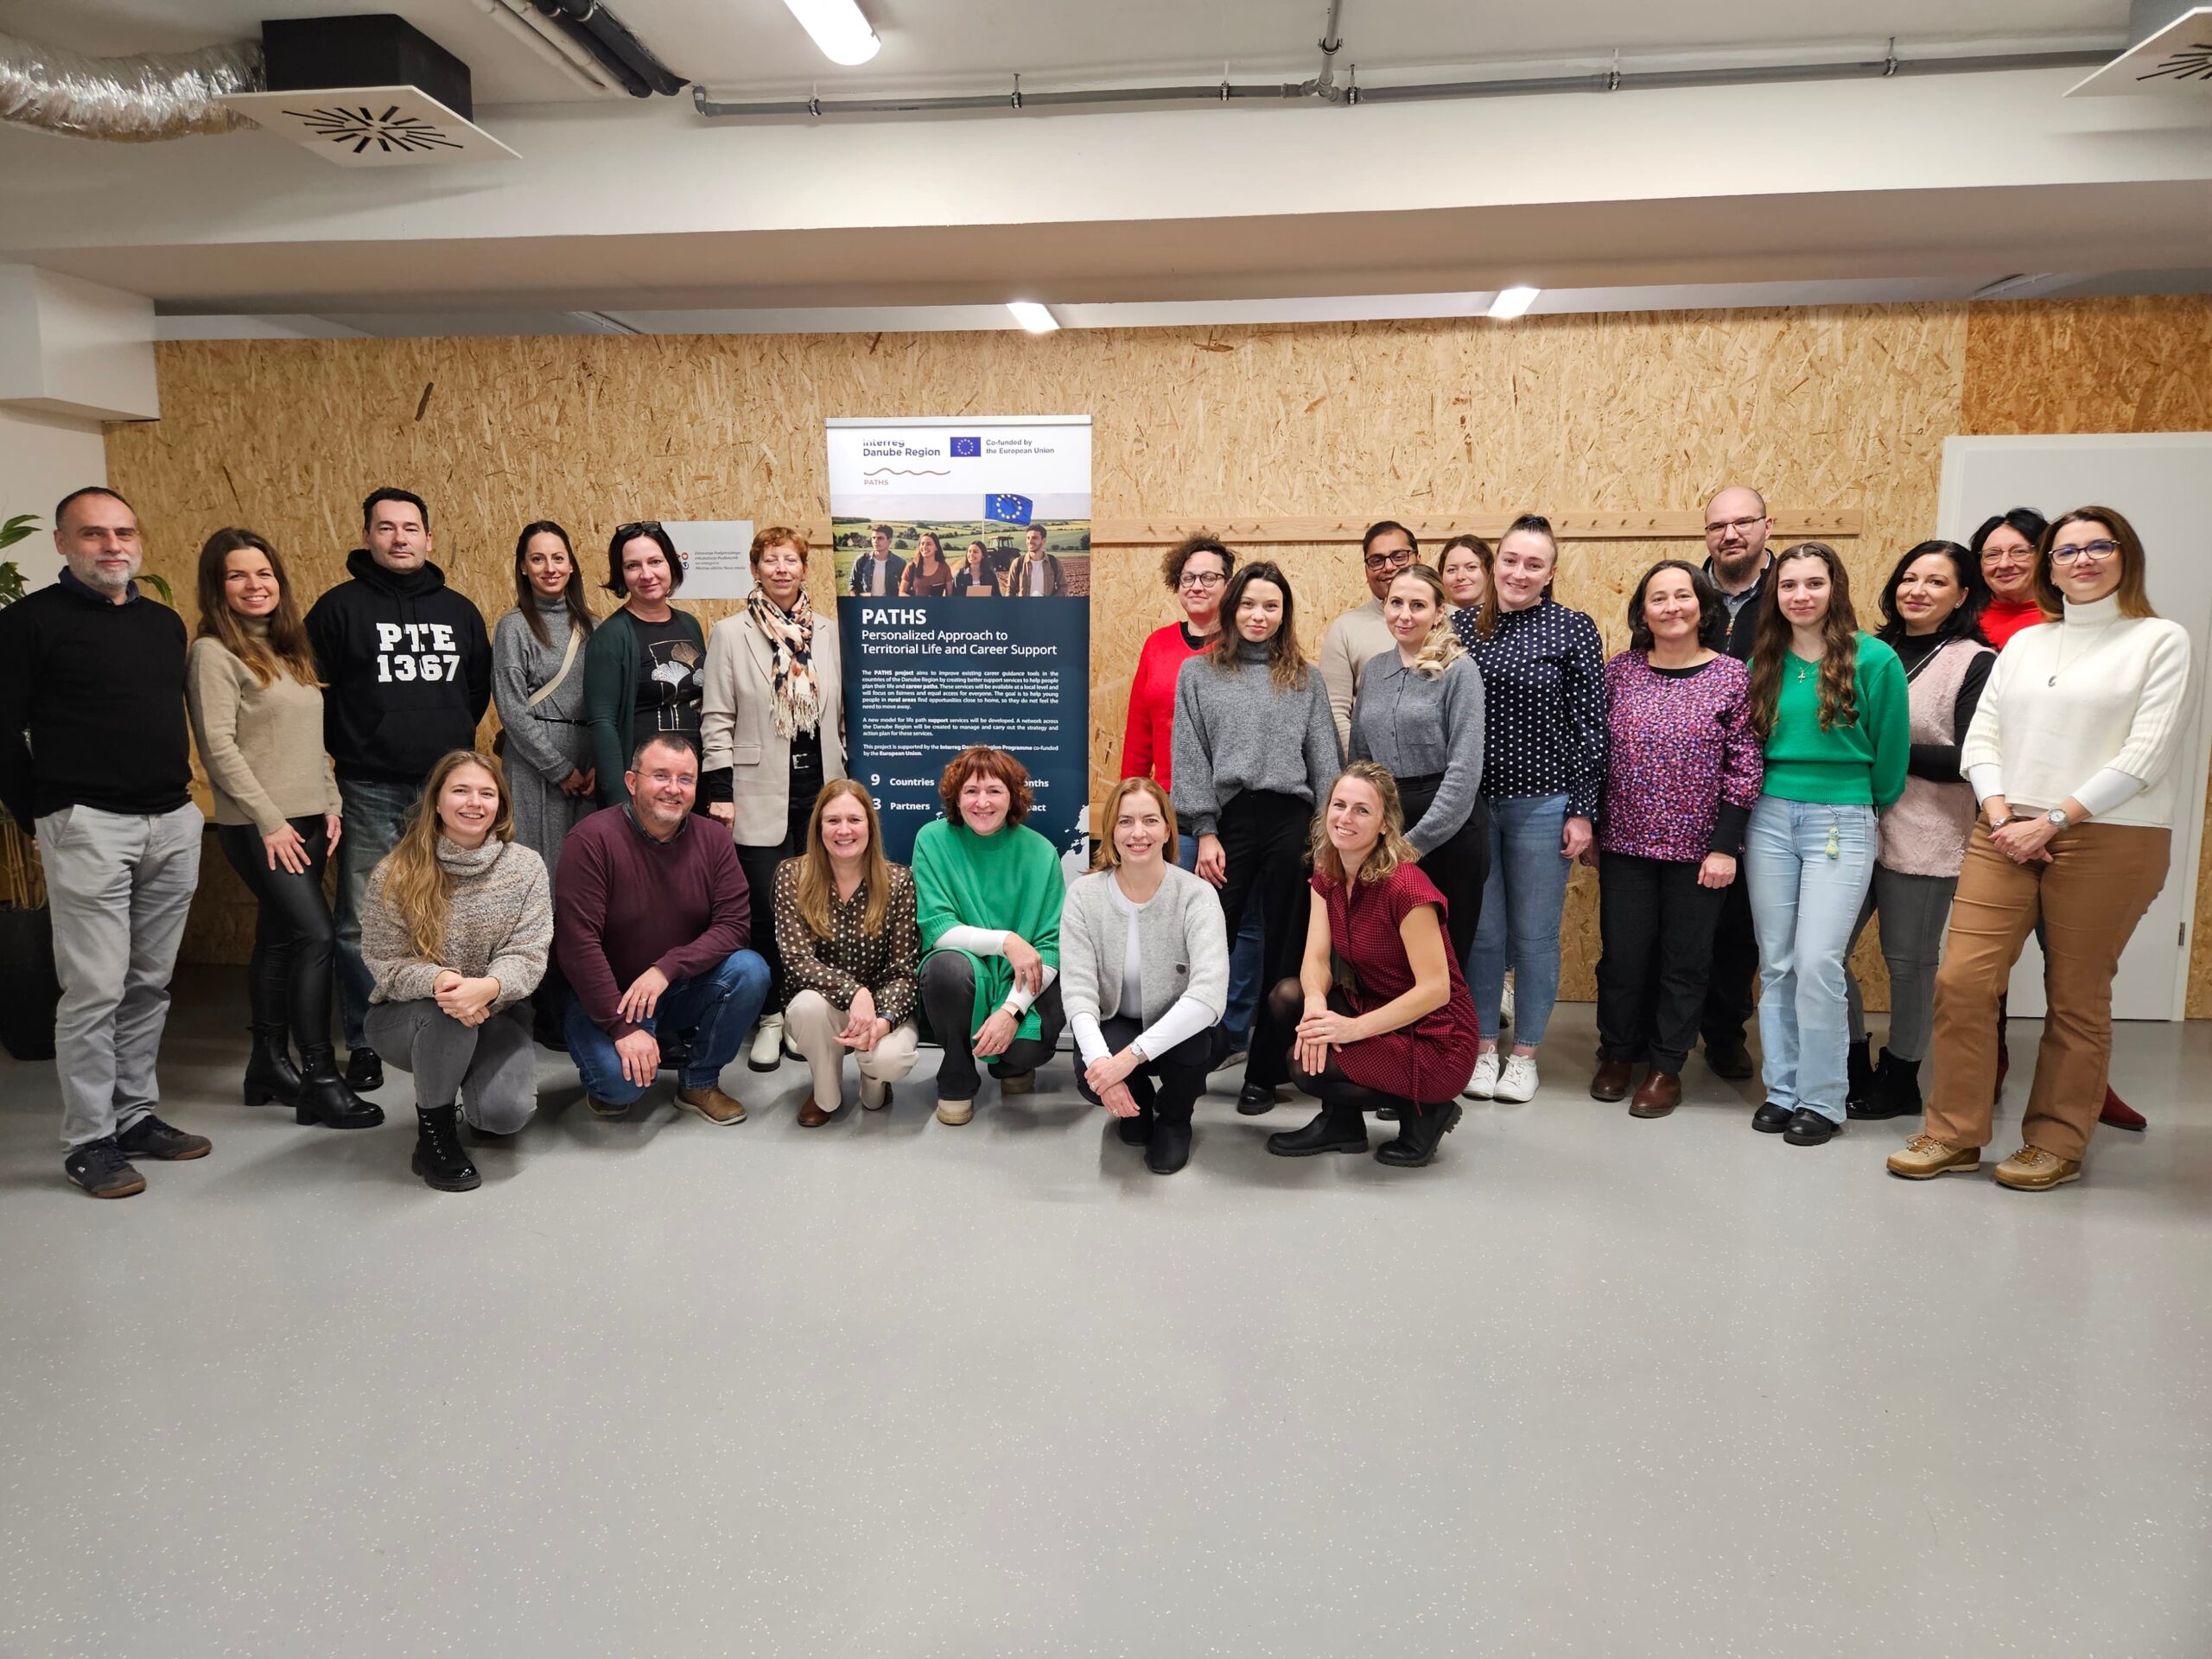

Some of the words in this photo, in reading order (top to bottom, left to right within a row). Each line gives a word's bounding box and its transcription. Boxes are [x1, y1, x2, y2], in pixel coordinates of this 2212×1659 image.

[863, 448, 902, 456] Danube
[905, 448, 940, 457] Region
[862, 609, 926, 624] PATHS
[376, 623, 456, 652] PTE
[862, 630, 935, 640] Personalized
[937, 630, 993, 642] Approach
[996, 632, 1008, 640] to
[862, 644, 918, 654] Territorial
[922, 644, 942, 654] Life
[945, 644, 967, 654] and
[969, 645, 1008, 654] Career
[1011, 645, 1057, 656] Support
[377, 655, 460, 682] 1367
[871, 774, 879, 785] 9
